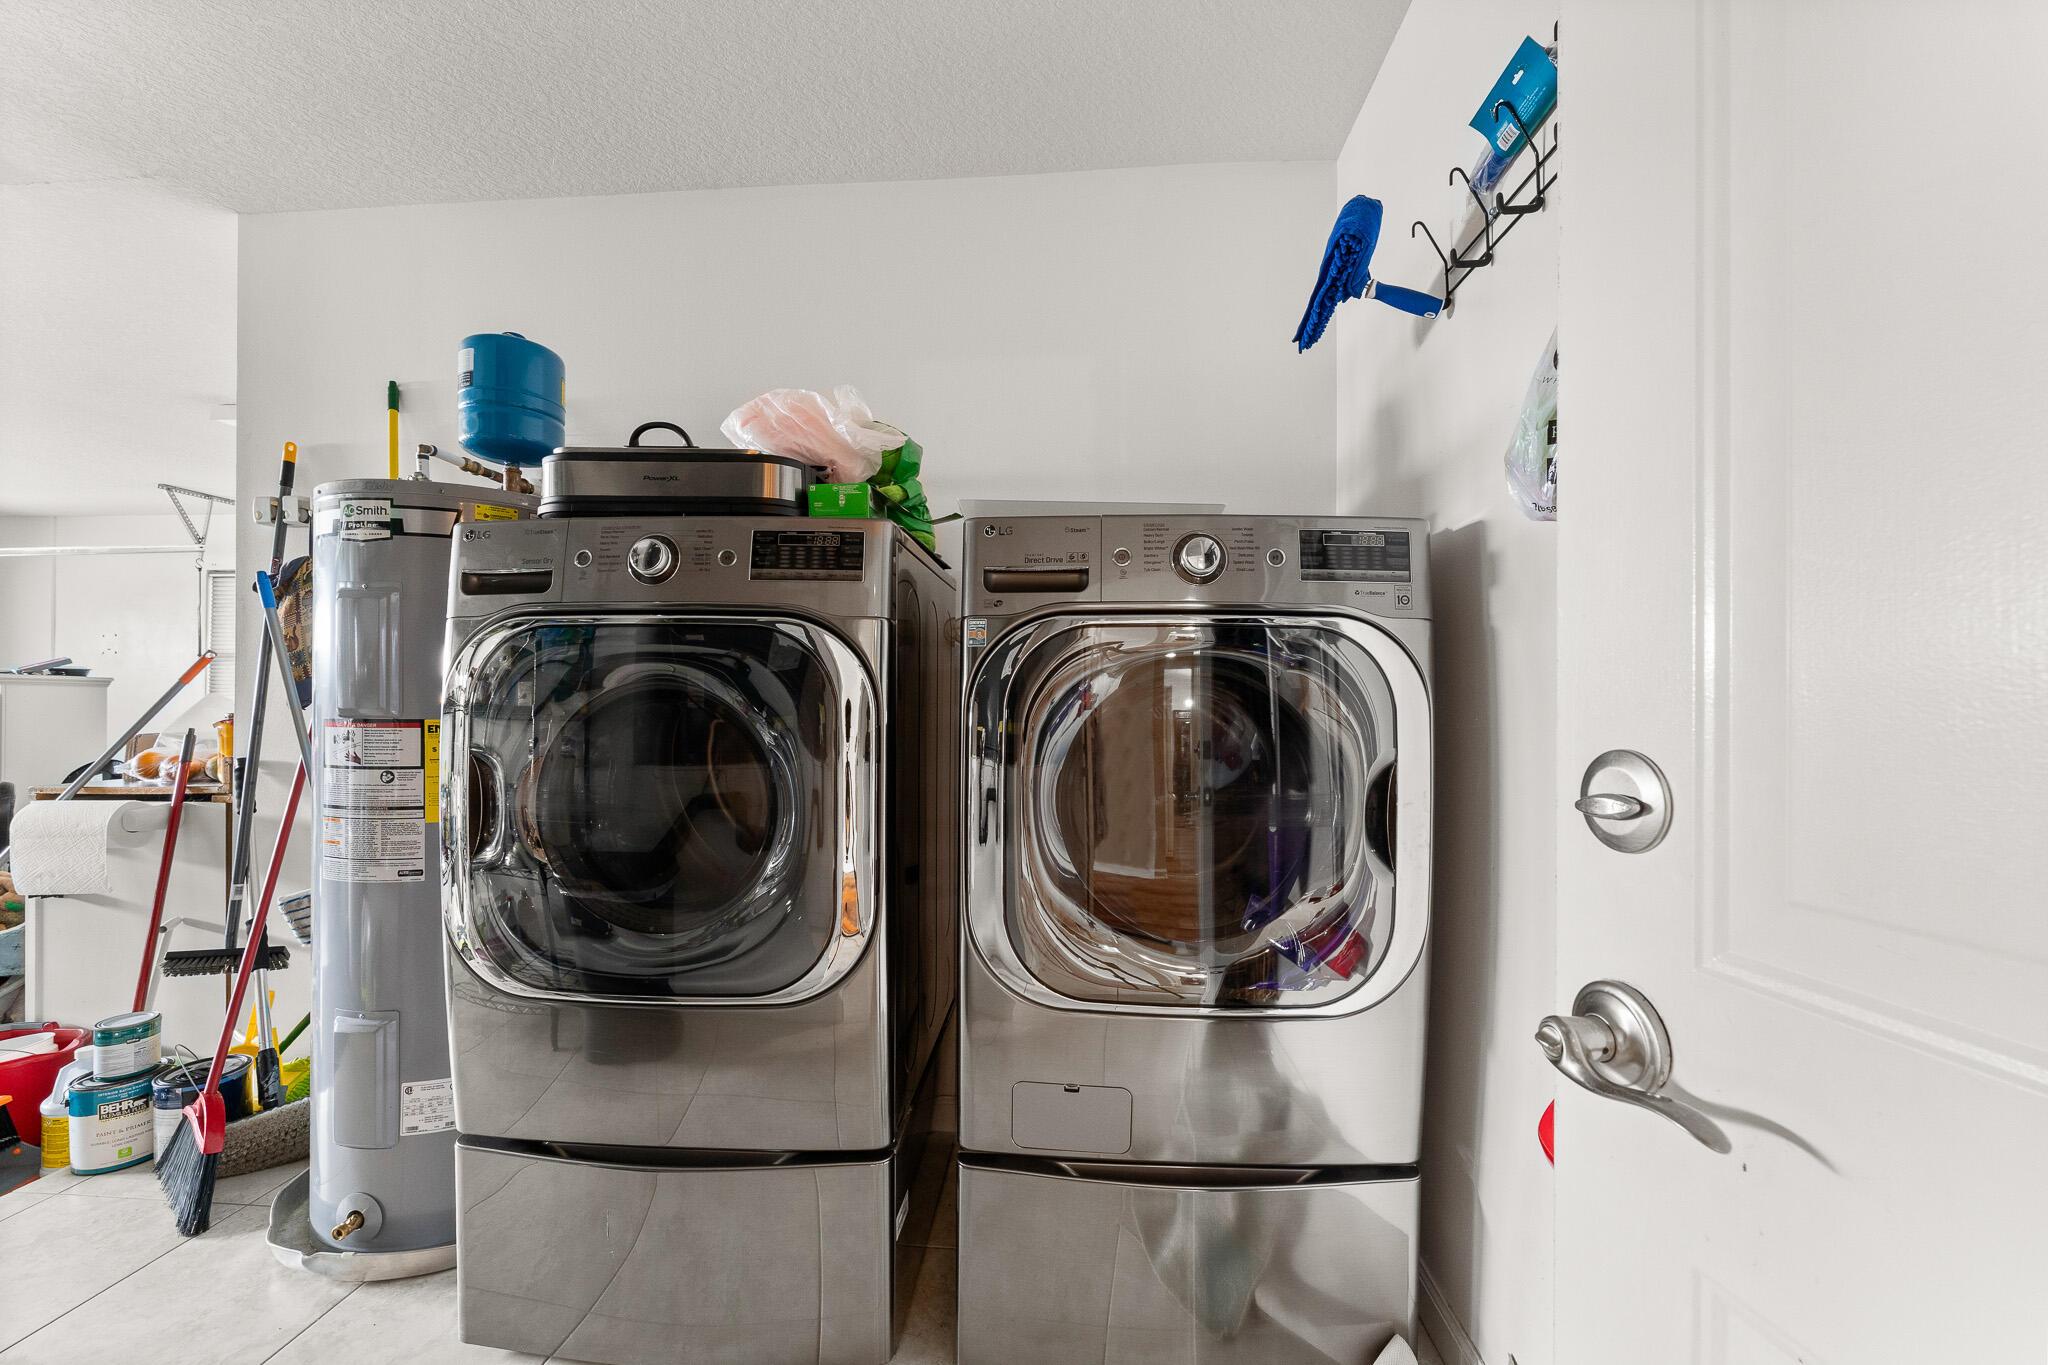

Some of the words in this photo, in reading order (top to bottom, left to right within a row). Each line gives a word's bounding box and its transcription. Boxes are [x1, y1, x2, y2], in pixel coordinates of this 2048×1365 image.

[355, 505, 388, 515] Smith
[998, 526, 1013, 536] LG
[1024, 556, 1045, 564] Direct
[100, 1099, 135, 1114] BEHR
